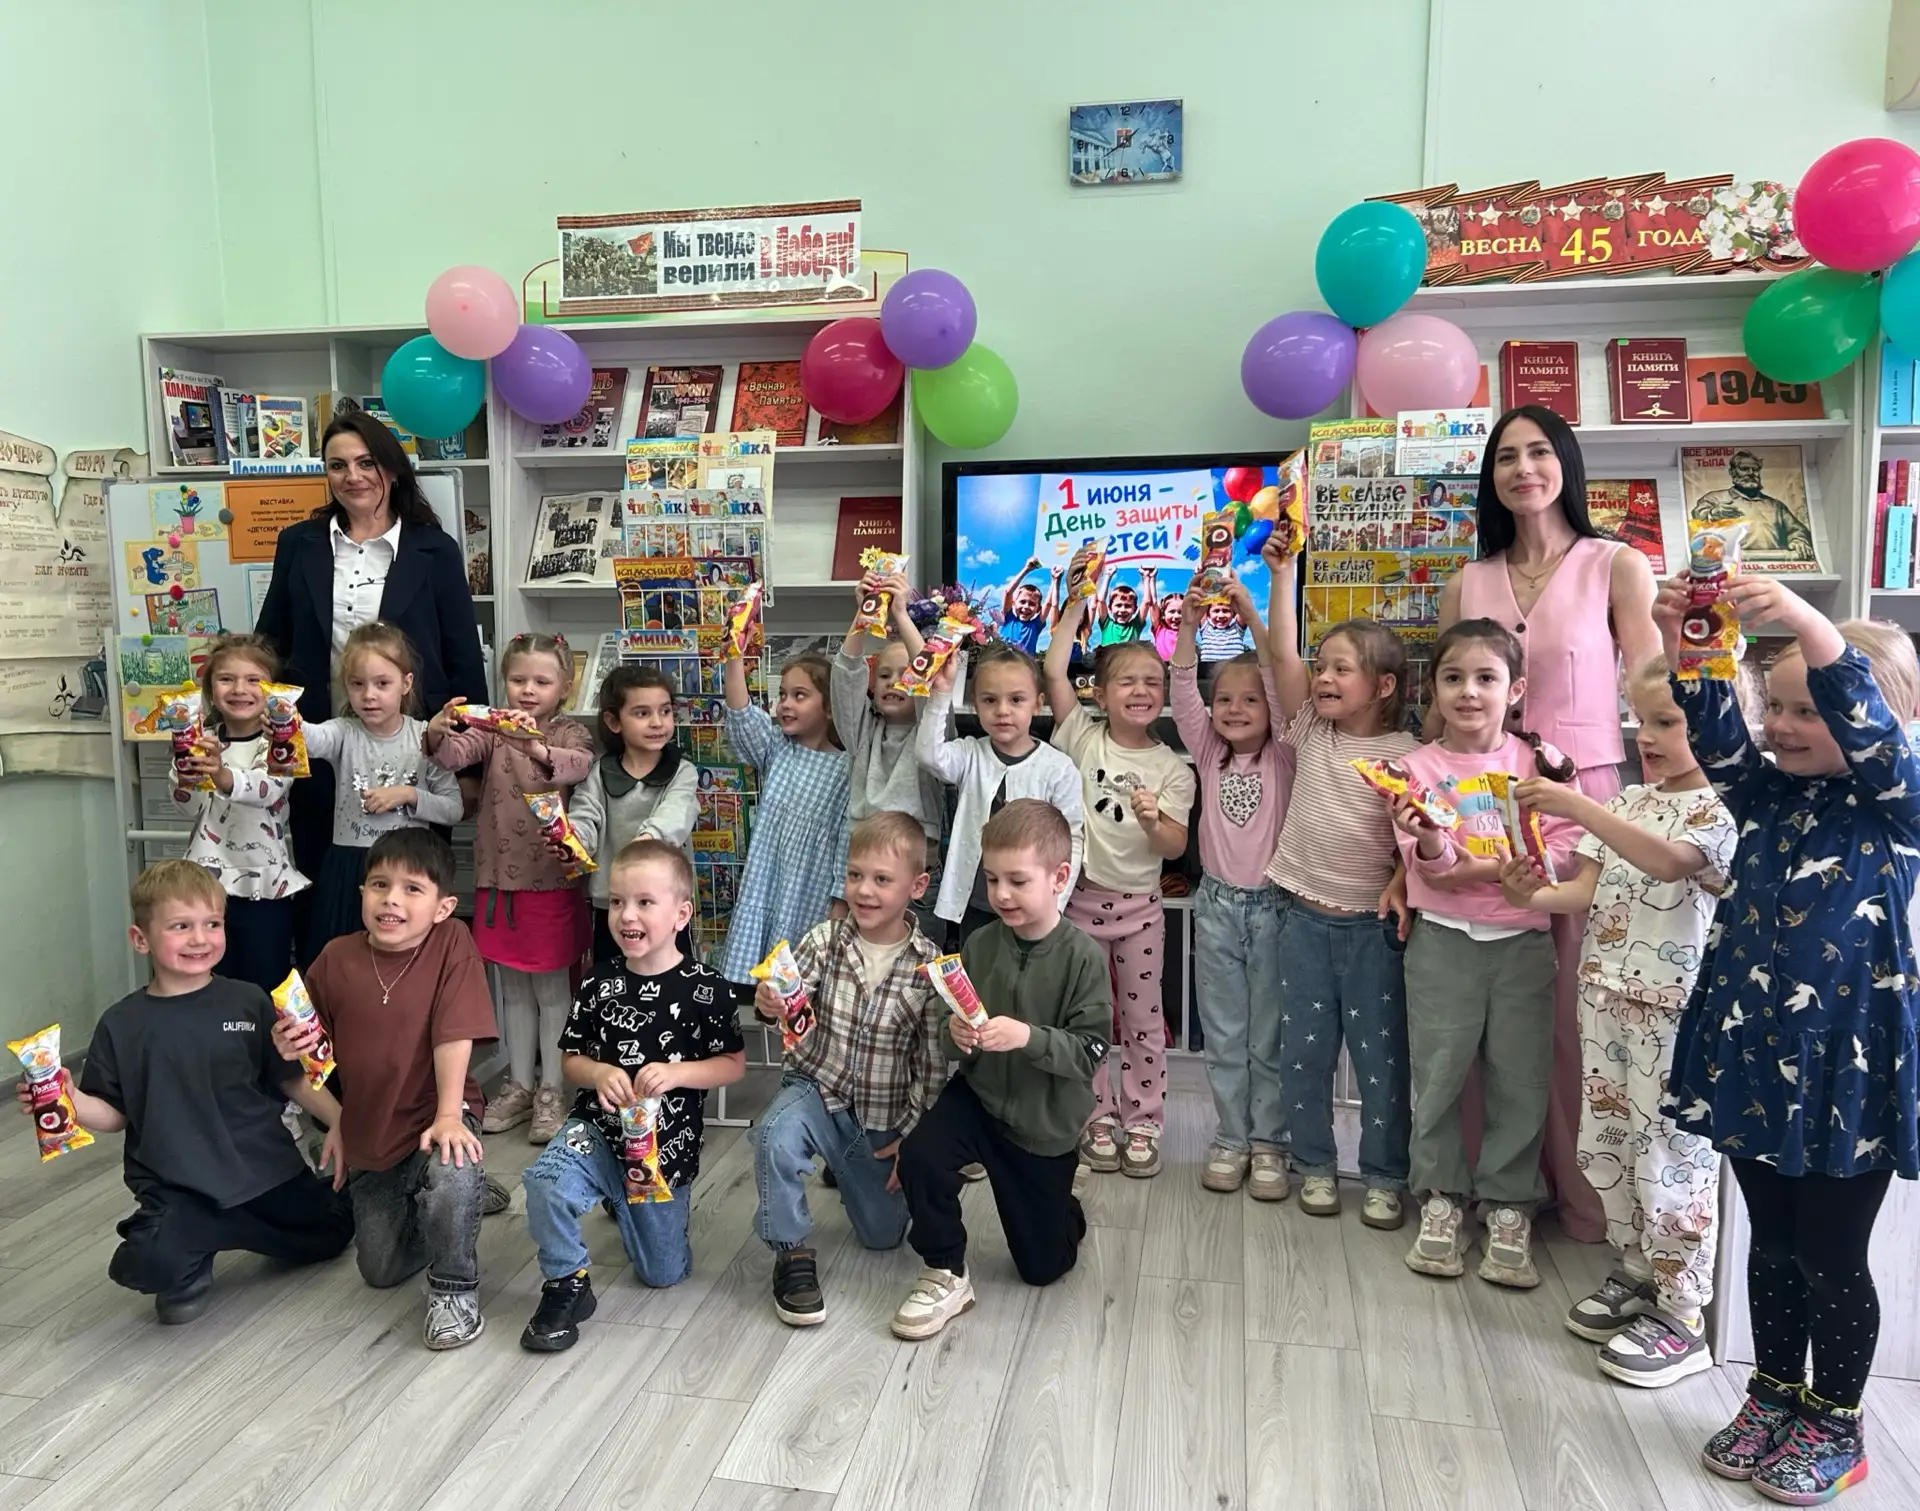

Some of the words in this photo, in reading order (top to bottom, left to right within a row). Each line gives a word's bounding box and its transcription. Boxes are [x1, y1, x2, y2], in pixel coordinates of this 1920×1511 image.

[1120, 106, 1131, 116] 12
[1121, 168, 1129, 178] 6
[663, 230, 691, 259] Мы
[697, 231, 756, 259] твердо
[1460, 235, 1542, 256] ВЕСНА
[1559, 226, 1613, 265] 45
[1638, 228, 1706, 247] ГОДА
[663, 263, 756, 286] верили
[1523, 356, 1564, 365] КНИГА
[1632, 352, 1673, 362] КНИГА
[1519, 366, 1569, 375] ПАМЯТИ
[1627, 363, 1680, 372] ПАМЯТИ
[743, 381, 786, 393] «Вечная
[1696, 370, 1808, 405] 1945
[759, 395, 802, 406] Память»
[1402, 420, 1488, 438] ЧИТАЙКА
[702, 440, 772, 457] ЧИТАЙКА
[1683, 448, 1702, 457] ВСЕ
[1705, 447, 1735, 457] СИЛЫ
[1695, 458, 1726, 468] ТЫЛА
[1057, 478, 1080, 510] 1
[1087, 483, 1151, 506] июня
[1585, 491, 1608, 500] ЕТИ
[259, 498, 295, 506] ВЫСТАВКА
[627, 500, 688, 515] ЧИТАЙК
[690, 500, 763, 516] ЧИТАЙКА
[1588, 500, 1628, 509] БАНИ
[858, 519, 892, 527] КНИГА
[1044, 512, 1106, 541] День
[1115, 503, 1199, 528] защиты
[853, 527, 896, 535] ПАМЯТИ
[616, 564, 678, 578] КЛАССНЫЙ
[1313, 557, 1375, 572] ВЕЕЛЫЕ
[629, 633, 682, 648] МИША
[1476, 815, 1486, 831] IS
[1487, 815, 1499, 831] SO
[599, 978, 624, 998] 23
[617, 1039, 646, 1066] Z
